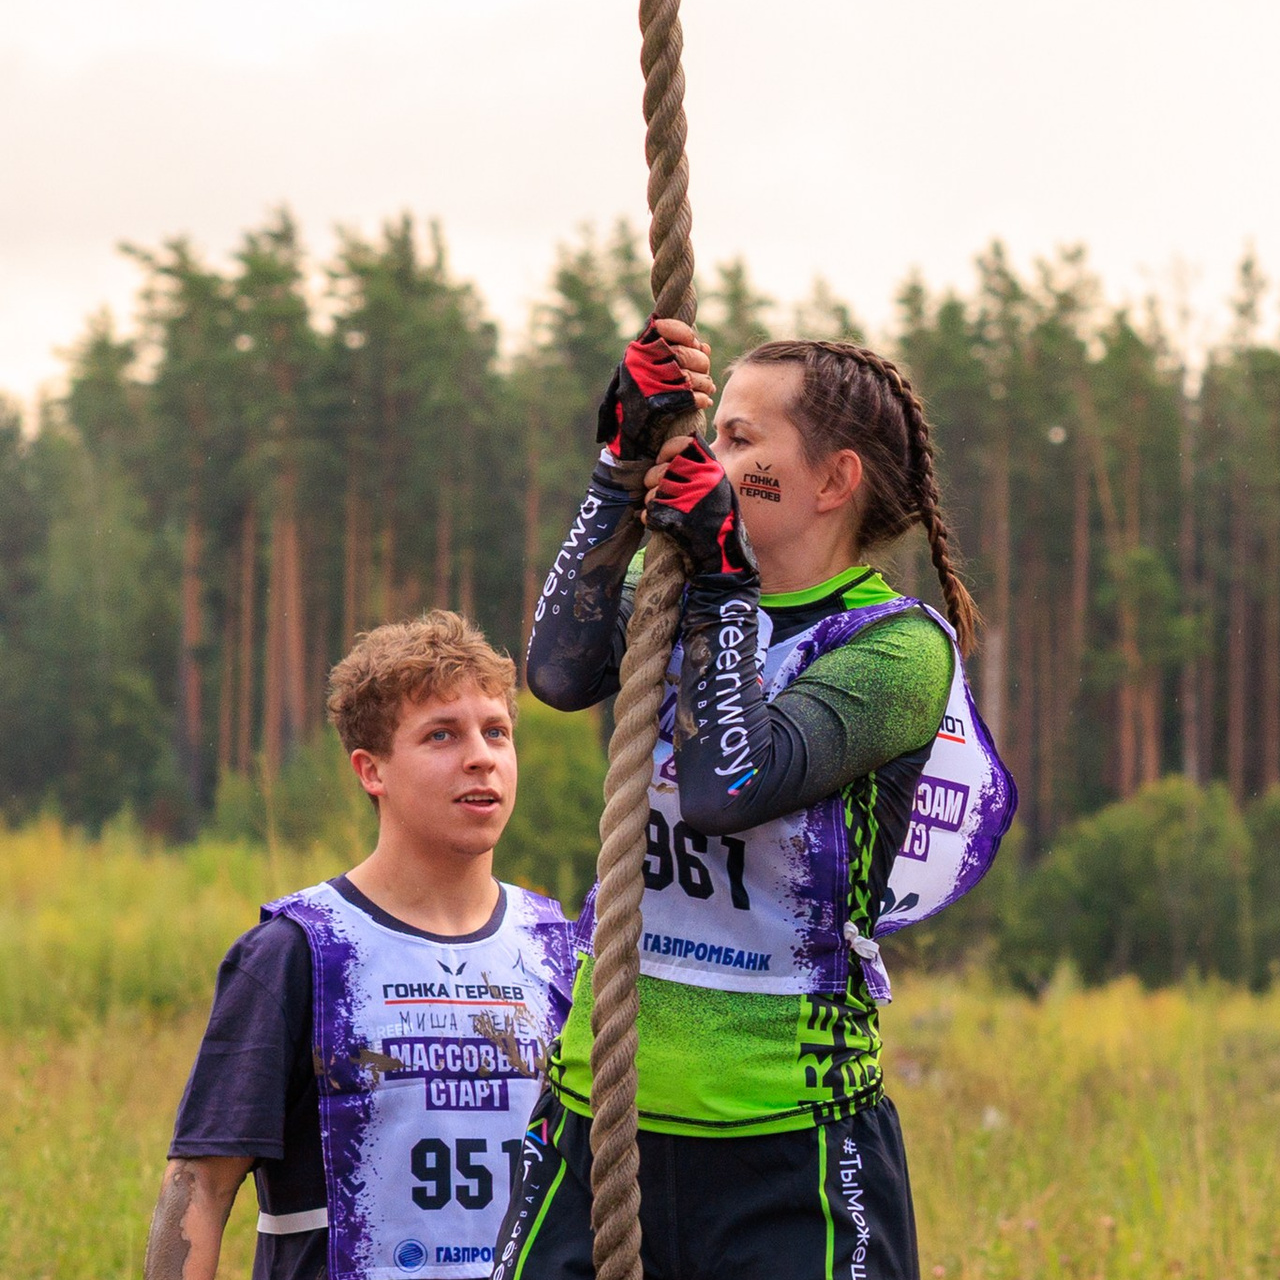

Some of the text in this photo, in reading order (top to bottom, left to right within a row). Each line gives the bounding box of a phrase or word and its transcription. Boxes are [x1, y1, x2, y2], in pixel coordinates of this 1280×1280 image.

[743, 473, 780, 488] ГОНКА
[740, 486, 781, 503] ГЕРОЕВ
[643, 933, 772, 971] ГАЗПРОМБАНК
[383, 983, 525, 1001] ГОНКА ГЕРОЕВ
[431, 1079, 502, 1107] СТАРТ
[411, 1138, 523, 1210] 951
[436, 1247, 495, 1263] ГАЗПРО
